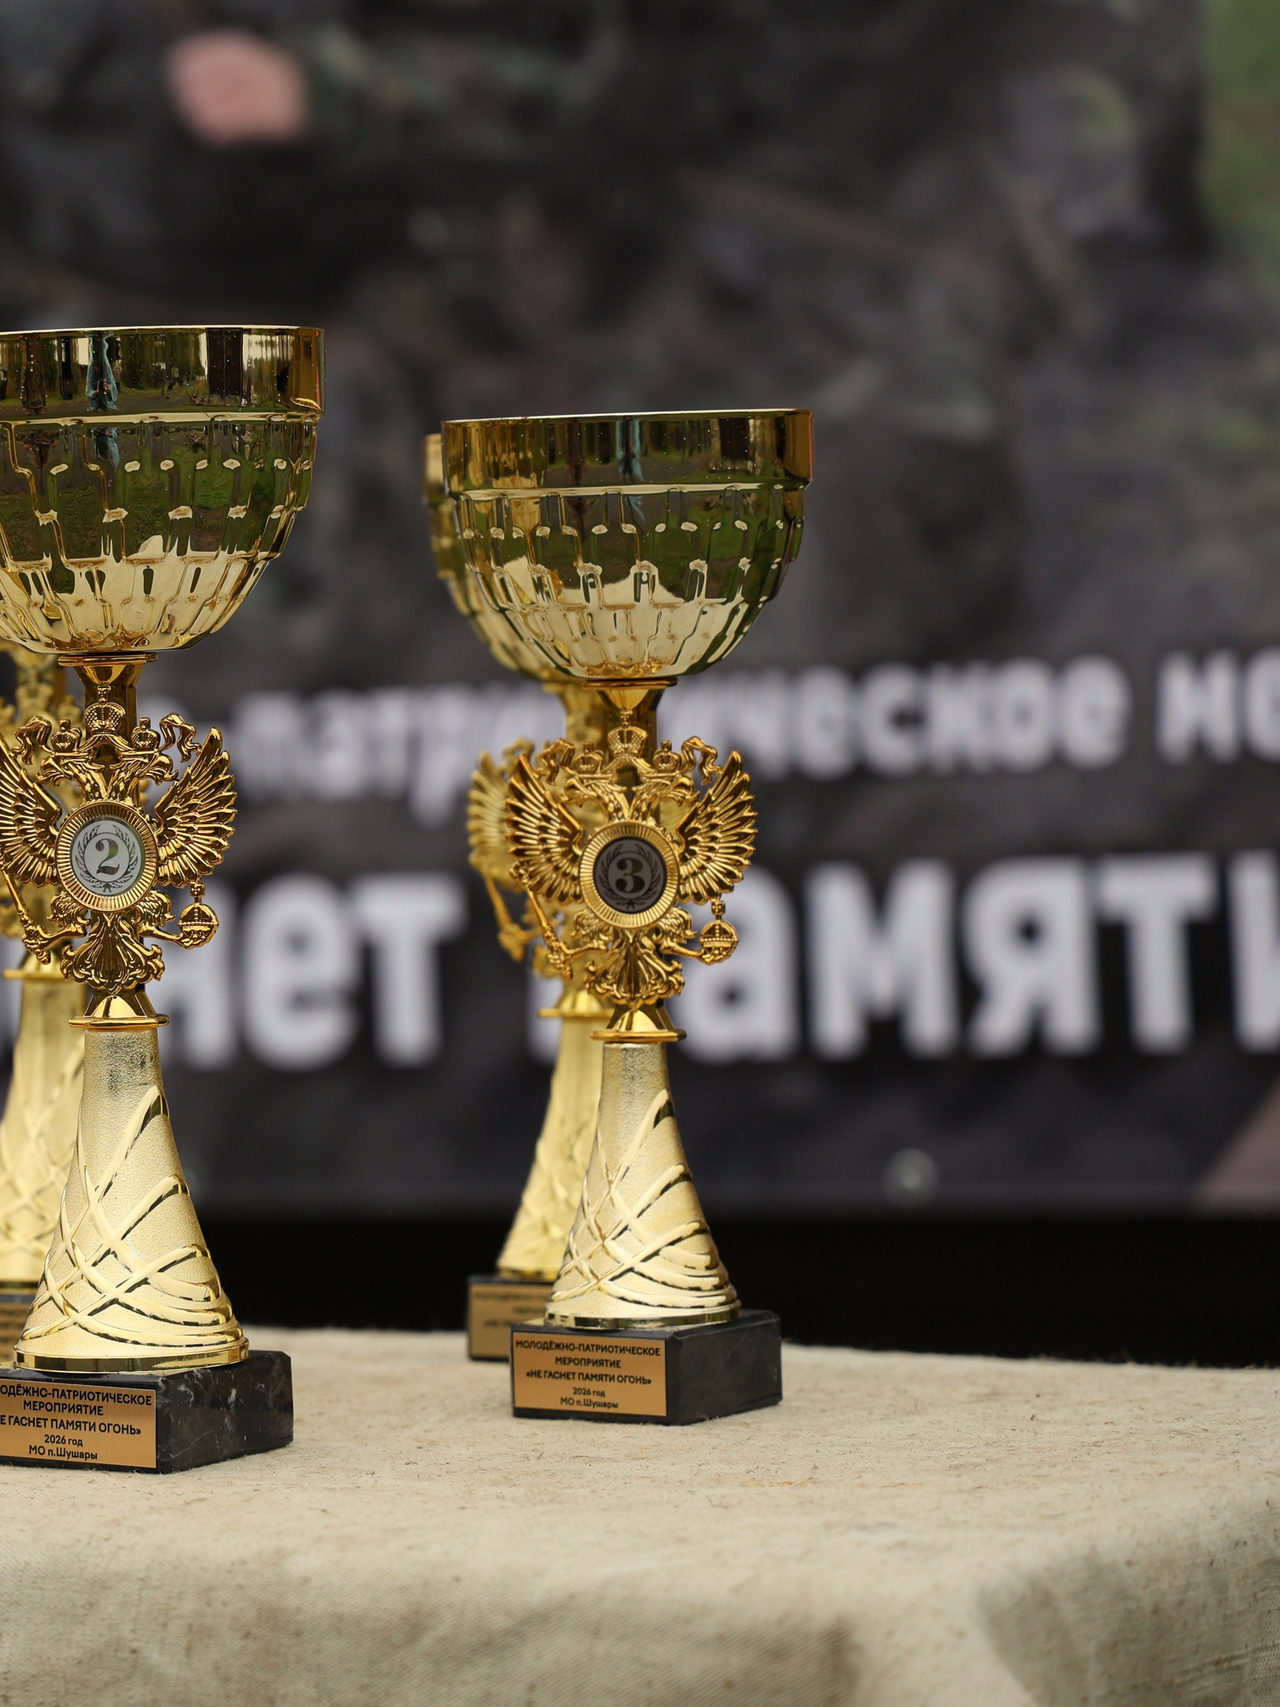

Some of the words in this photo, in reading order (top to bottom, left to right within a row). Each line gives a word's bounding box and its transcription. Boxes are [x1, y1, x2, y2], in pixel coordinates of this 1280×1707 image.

[95, 838, 120, 875] 2
[615, 858, 645, 893] 3
[532, 856, 1280, 1056] амят
[516, 1340, 661, 1356] МОЛОДЁЖНО-ПАТРИОТИЧЕСКОЕ
[555, 1356, 621, 1368] МЕРОПРИЯТИЕ
[526, 1369, 542, 1379] «НЕ
[543, 1370, 576, 1380] ГАСНЕТ
[578, 1372, 615, 1383] ПАМЯТИ
[617, 1374, 652, 1385] ОГОНЬ»
[573, 1386, 591, 1396] 2026
[23, 1400, 104, 1416] МЕРОПРИЯТИЕ
[560, 1396, 575, 1406] МО
[576, 1398, 618, 1410] п.Шушары
[8, 1415, 48, 1428] ГАСНЕТ
[50, 1419, 96, 1432] ПАМЯТИ
[98, 1422, 142, 1435] ОГОНЬ»
[44, 1434, 66, 1445] 2026
[68, 1438, 83, 1447] год
[29, 1445, 46, 1455] МО
[48, 1447, 98, 1461] п.Шушары
